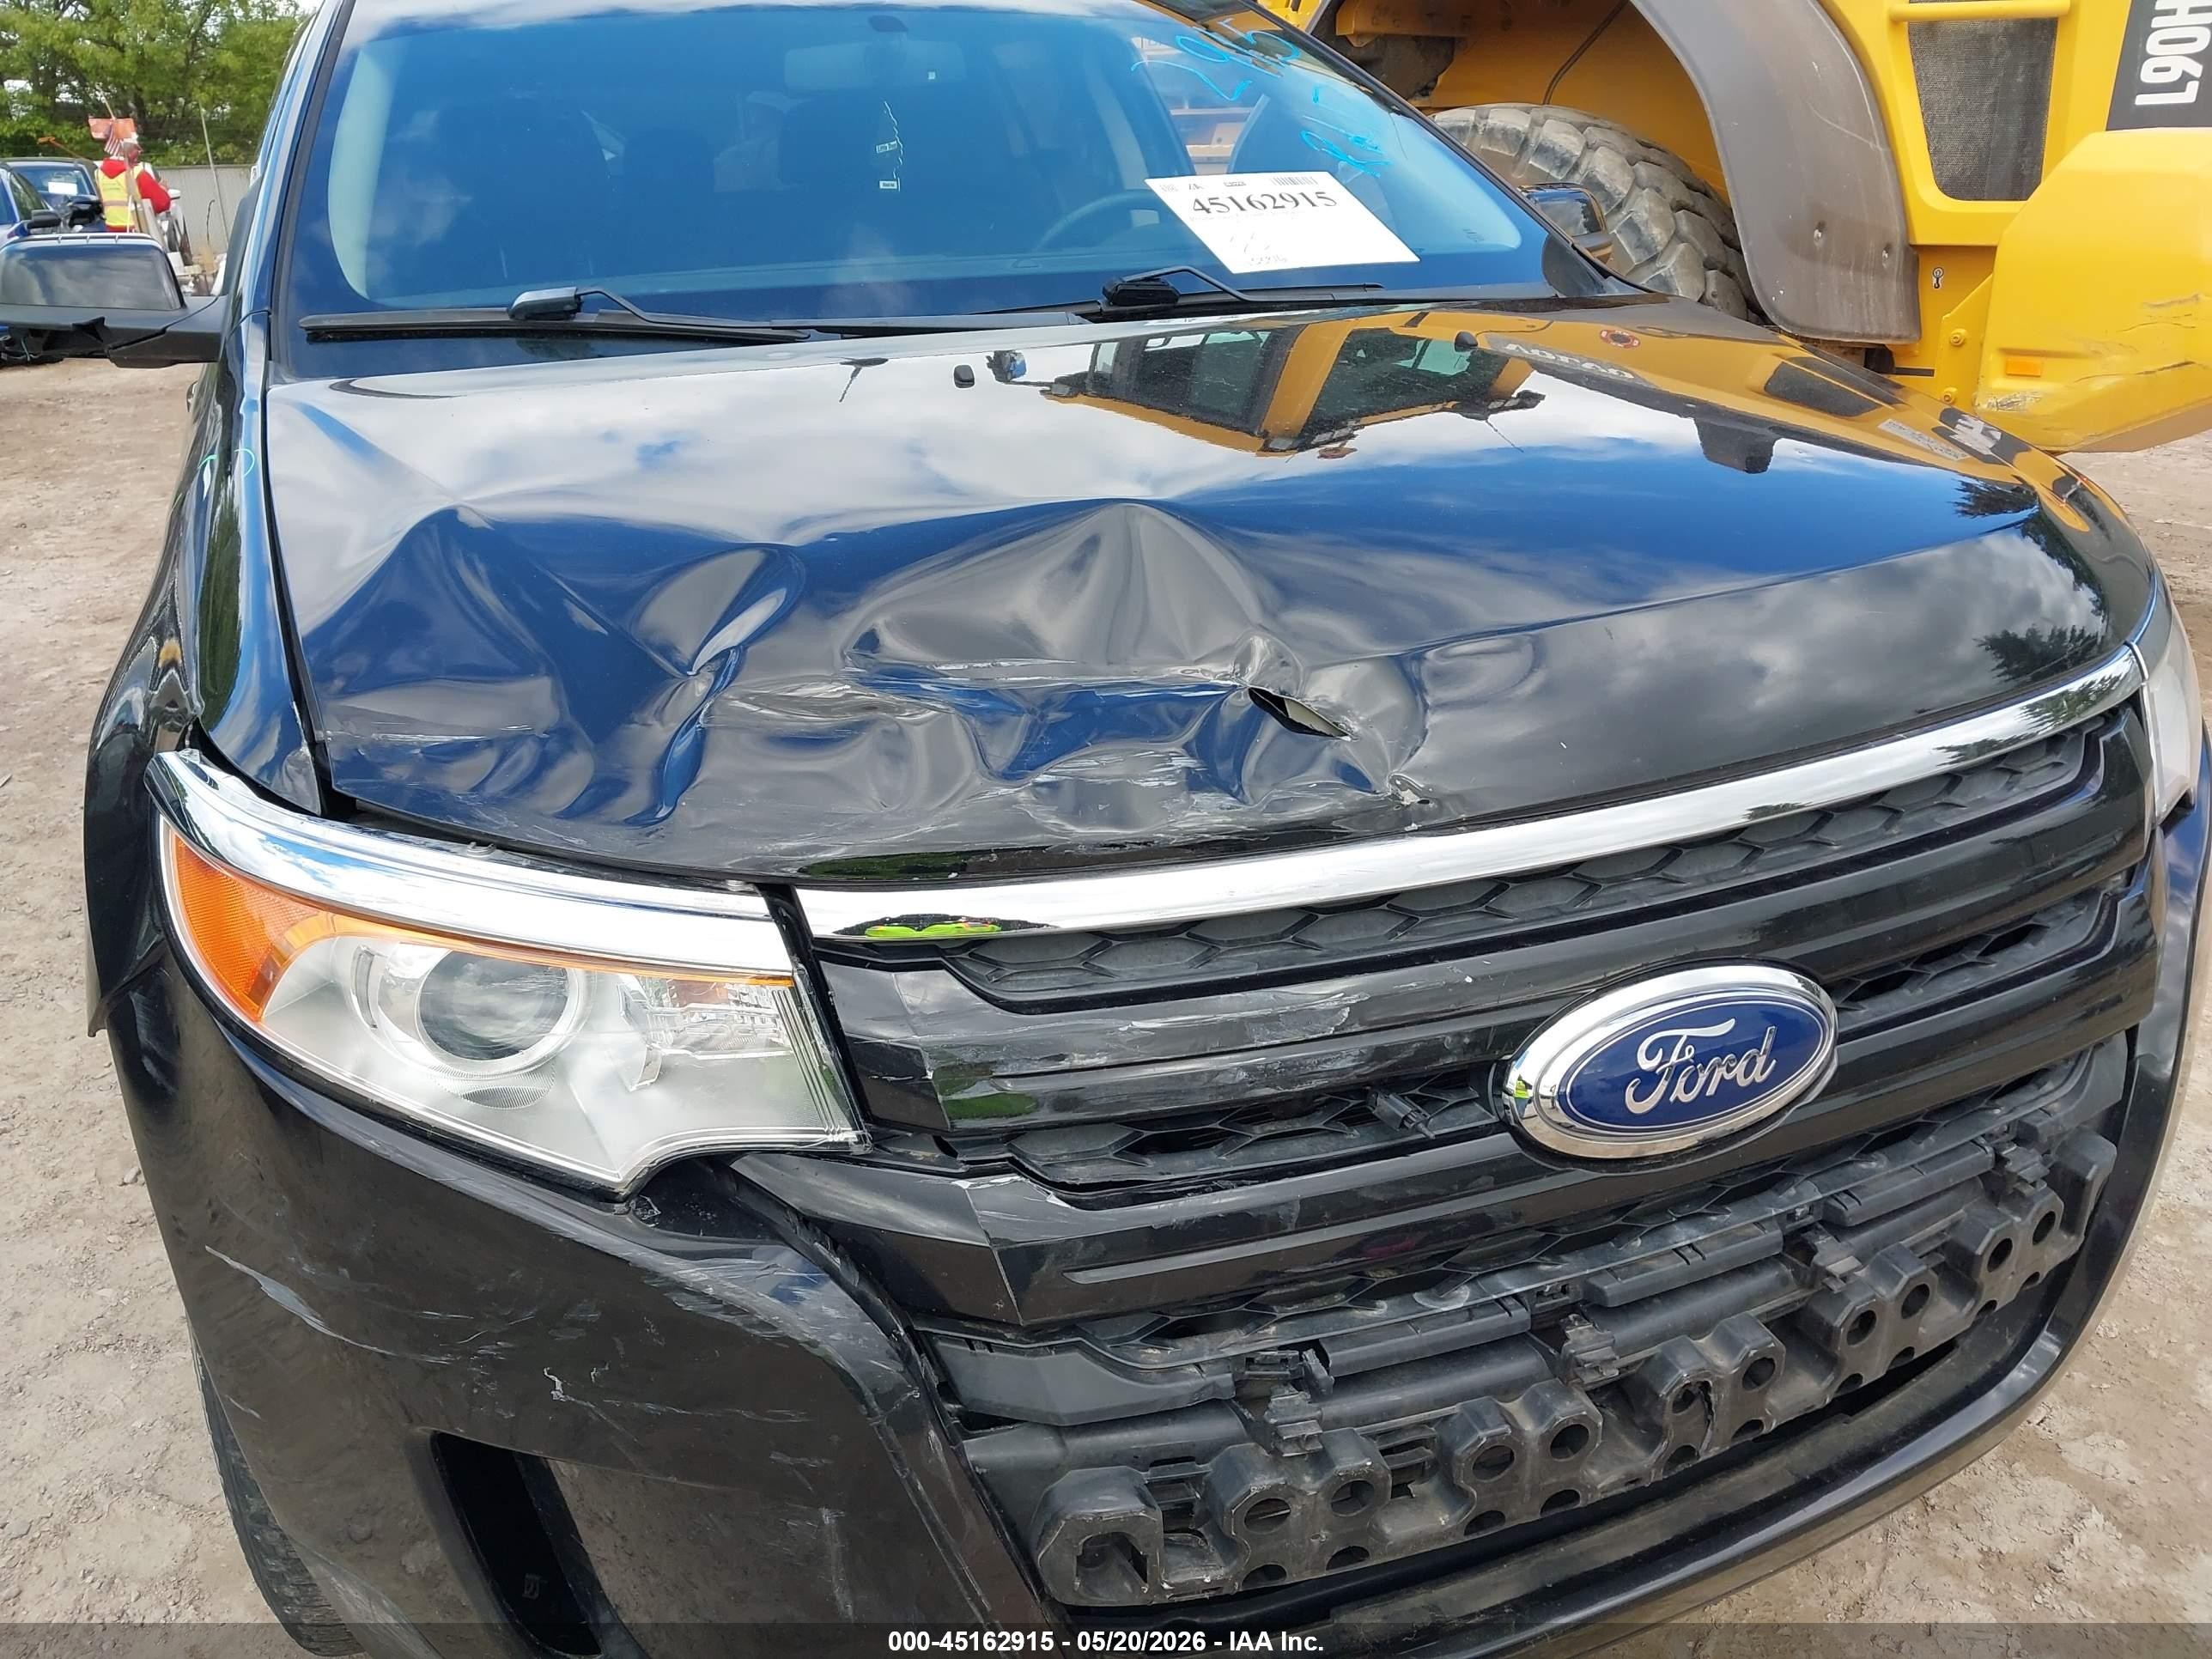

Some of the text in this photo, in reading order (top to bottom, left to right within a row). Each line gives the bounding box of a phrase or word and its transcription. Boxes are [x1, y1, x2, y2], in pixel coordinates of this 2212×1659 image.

[2135, 0, 2212, 106] L90H
[1193, 191, 1337, 214] 45162915
[1625, 1018, 1777, 1115] Ford
